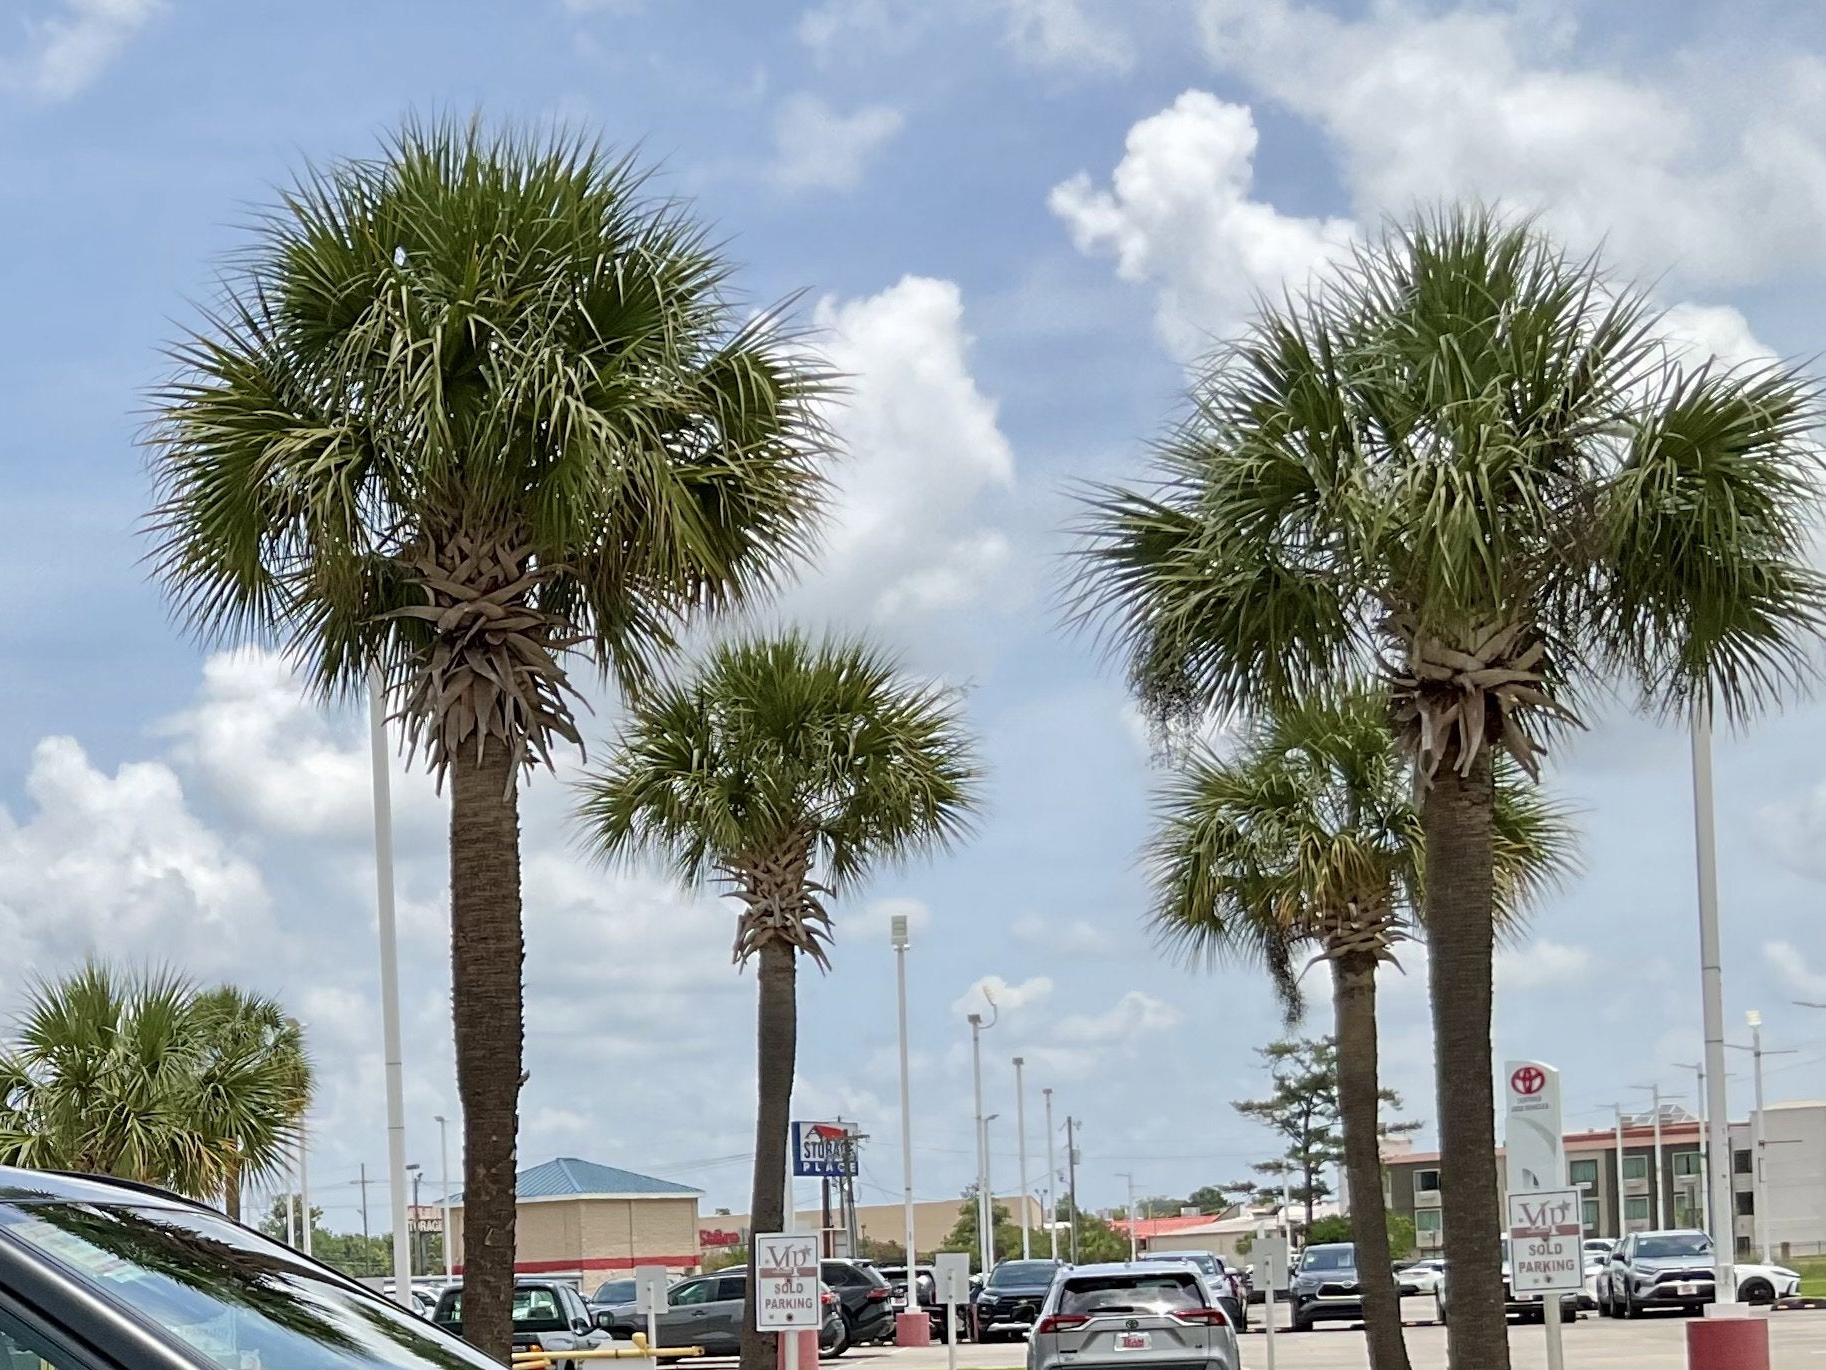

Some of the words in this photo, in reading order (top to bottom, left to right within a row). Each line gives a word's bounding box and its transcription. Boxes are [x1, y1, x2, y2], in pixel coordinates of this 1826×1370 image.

[803, 1162, 856, 1173] PLACE
[1528, 1243, 1562, 1256] SOLD
[1518, 1260, 1575, 1273] PARKING
[774, 1282, 804, 1294] SOLD
[765, 1298, 813, 1309] PARKING
